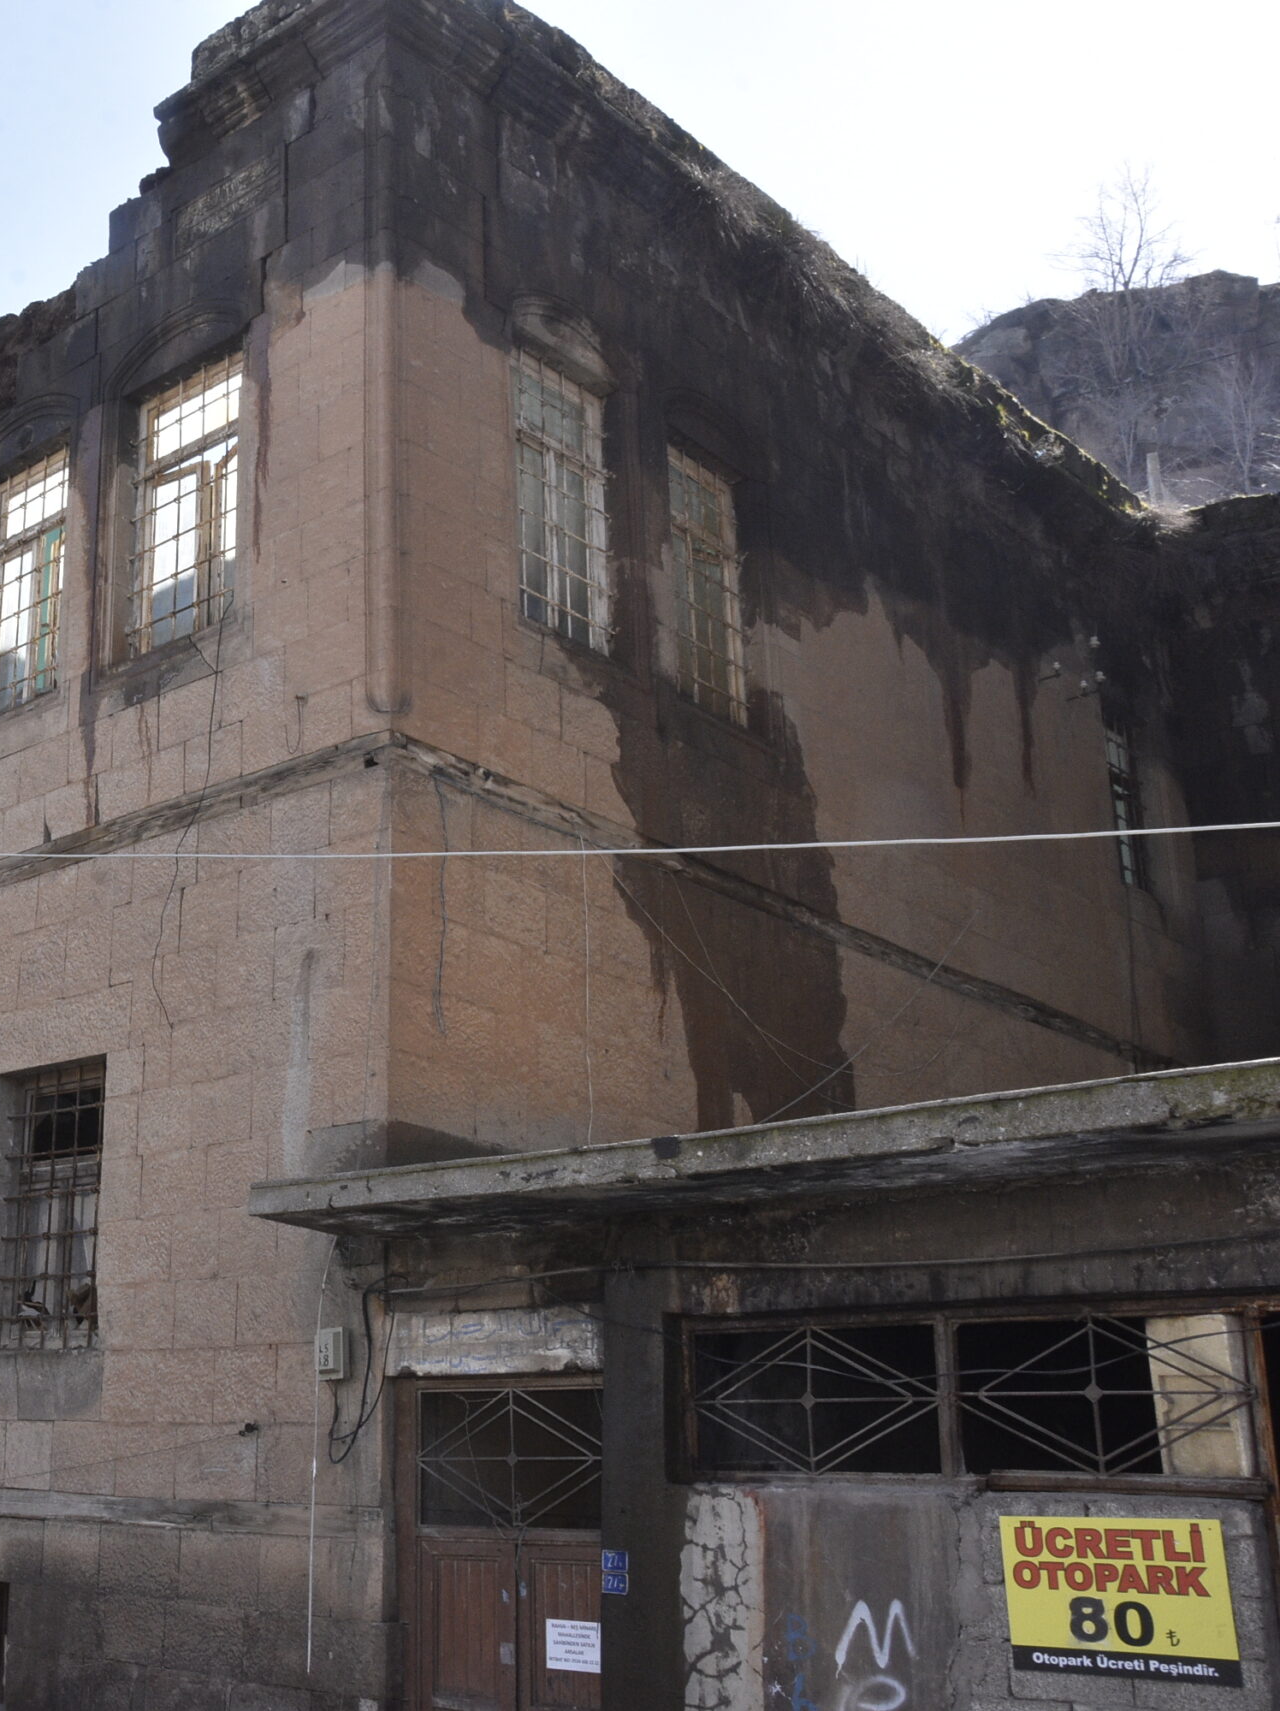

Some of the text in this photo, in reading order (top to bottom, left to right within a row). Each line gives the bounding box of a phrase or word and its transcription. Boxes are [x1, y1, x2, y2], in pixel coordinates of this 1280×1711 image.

[1014, 1521, 1205, 1562] ÜCRETLİ
[1013, 1561, 1211, 1597] OTOPARK
[1069, 1596, 1154, 1647] 80
[1032, 1651, 1219, 1677] Otopark Ücreti Peşindir.
